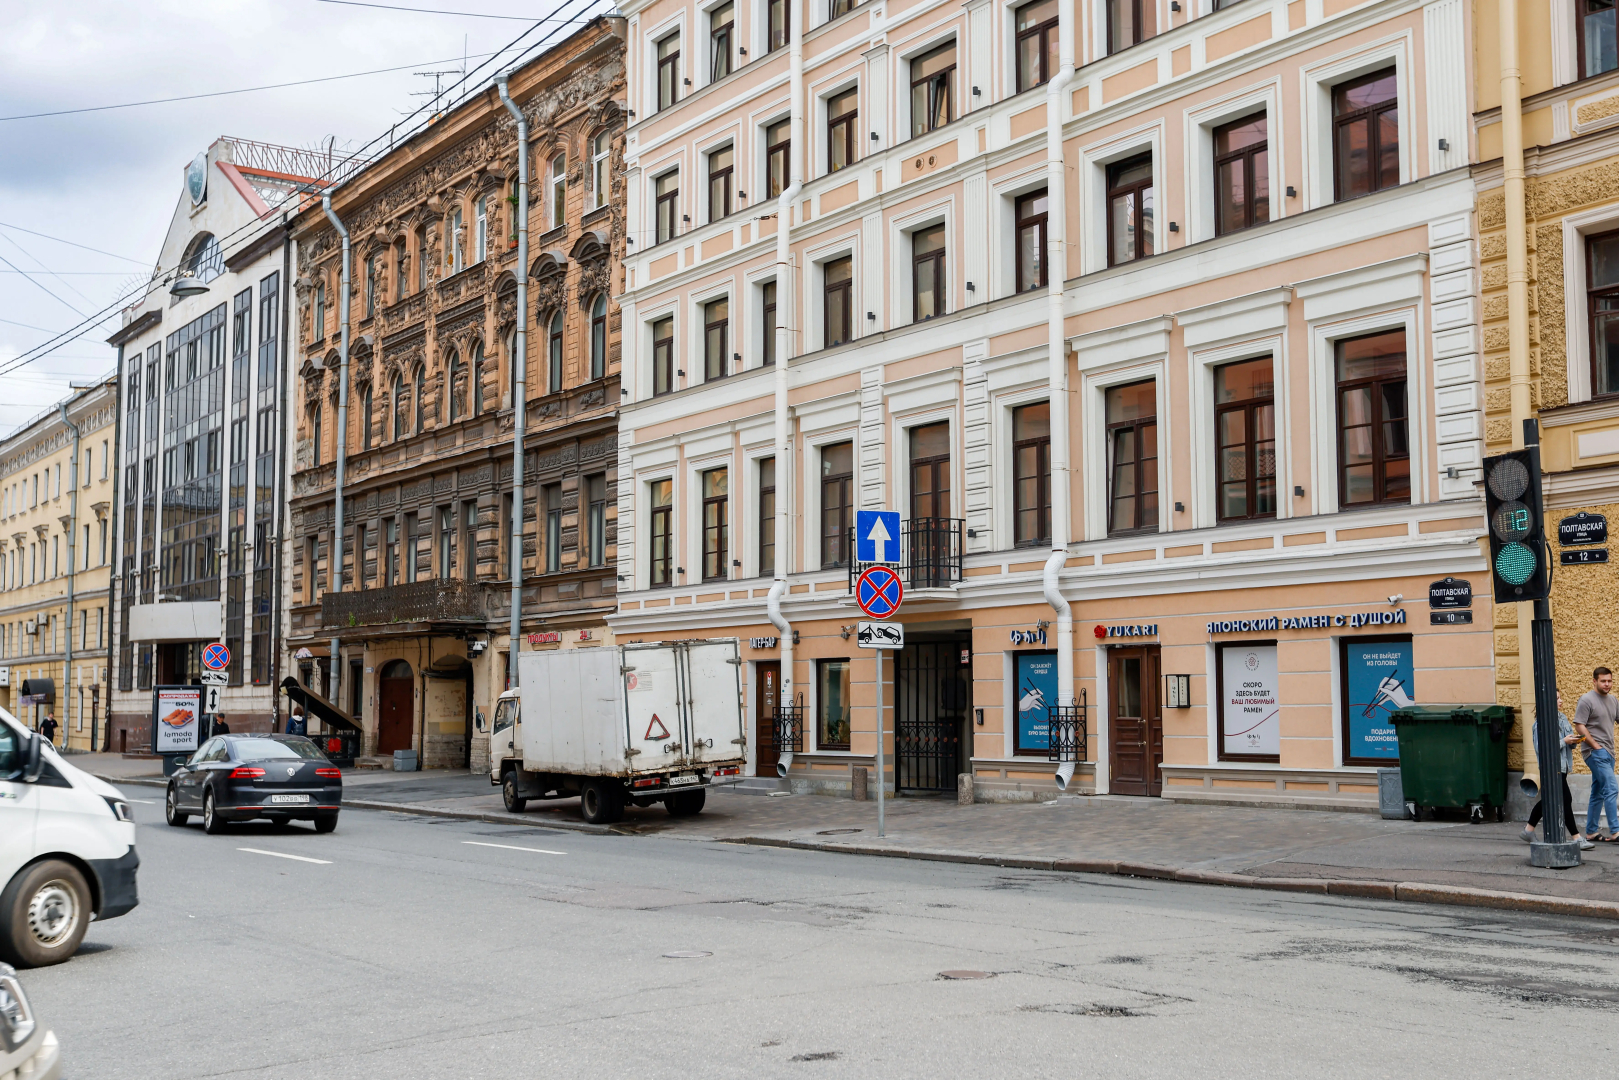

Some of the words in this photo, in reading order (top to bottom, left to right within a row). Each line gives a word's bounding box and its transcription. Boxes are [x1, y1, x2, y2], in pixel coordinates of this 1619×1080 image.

[1511, 509, 1528, 531] 12
[1561, 522, 1603, 533] ПОЛТАВСКАЯ
[1579, 551, 1588, 561] 12
[1431, 587, 1469, 597] ПОЛТАВСКАЯ
[1206, 616, 1278, 633] ЯПОНСКИЙ
[1281, 615, 1330, 629] РАМЕН
[1334, 614, 1346, 627] С
[1350, 609, 1406, 627] ДУШОЙ
[1447, 613, 1455, 622] 10
[1107, 624, 1158, 637] YUKARI
[527, 632, 559, 644] ПРОДУКТЫ
[1009, 628, 1047, 646] ゆかり
[1380, 652, 1401, 660] ВЫЙДЕТ
[1244, 697, 1275, 705] ЛЮБИМЫЙ
